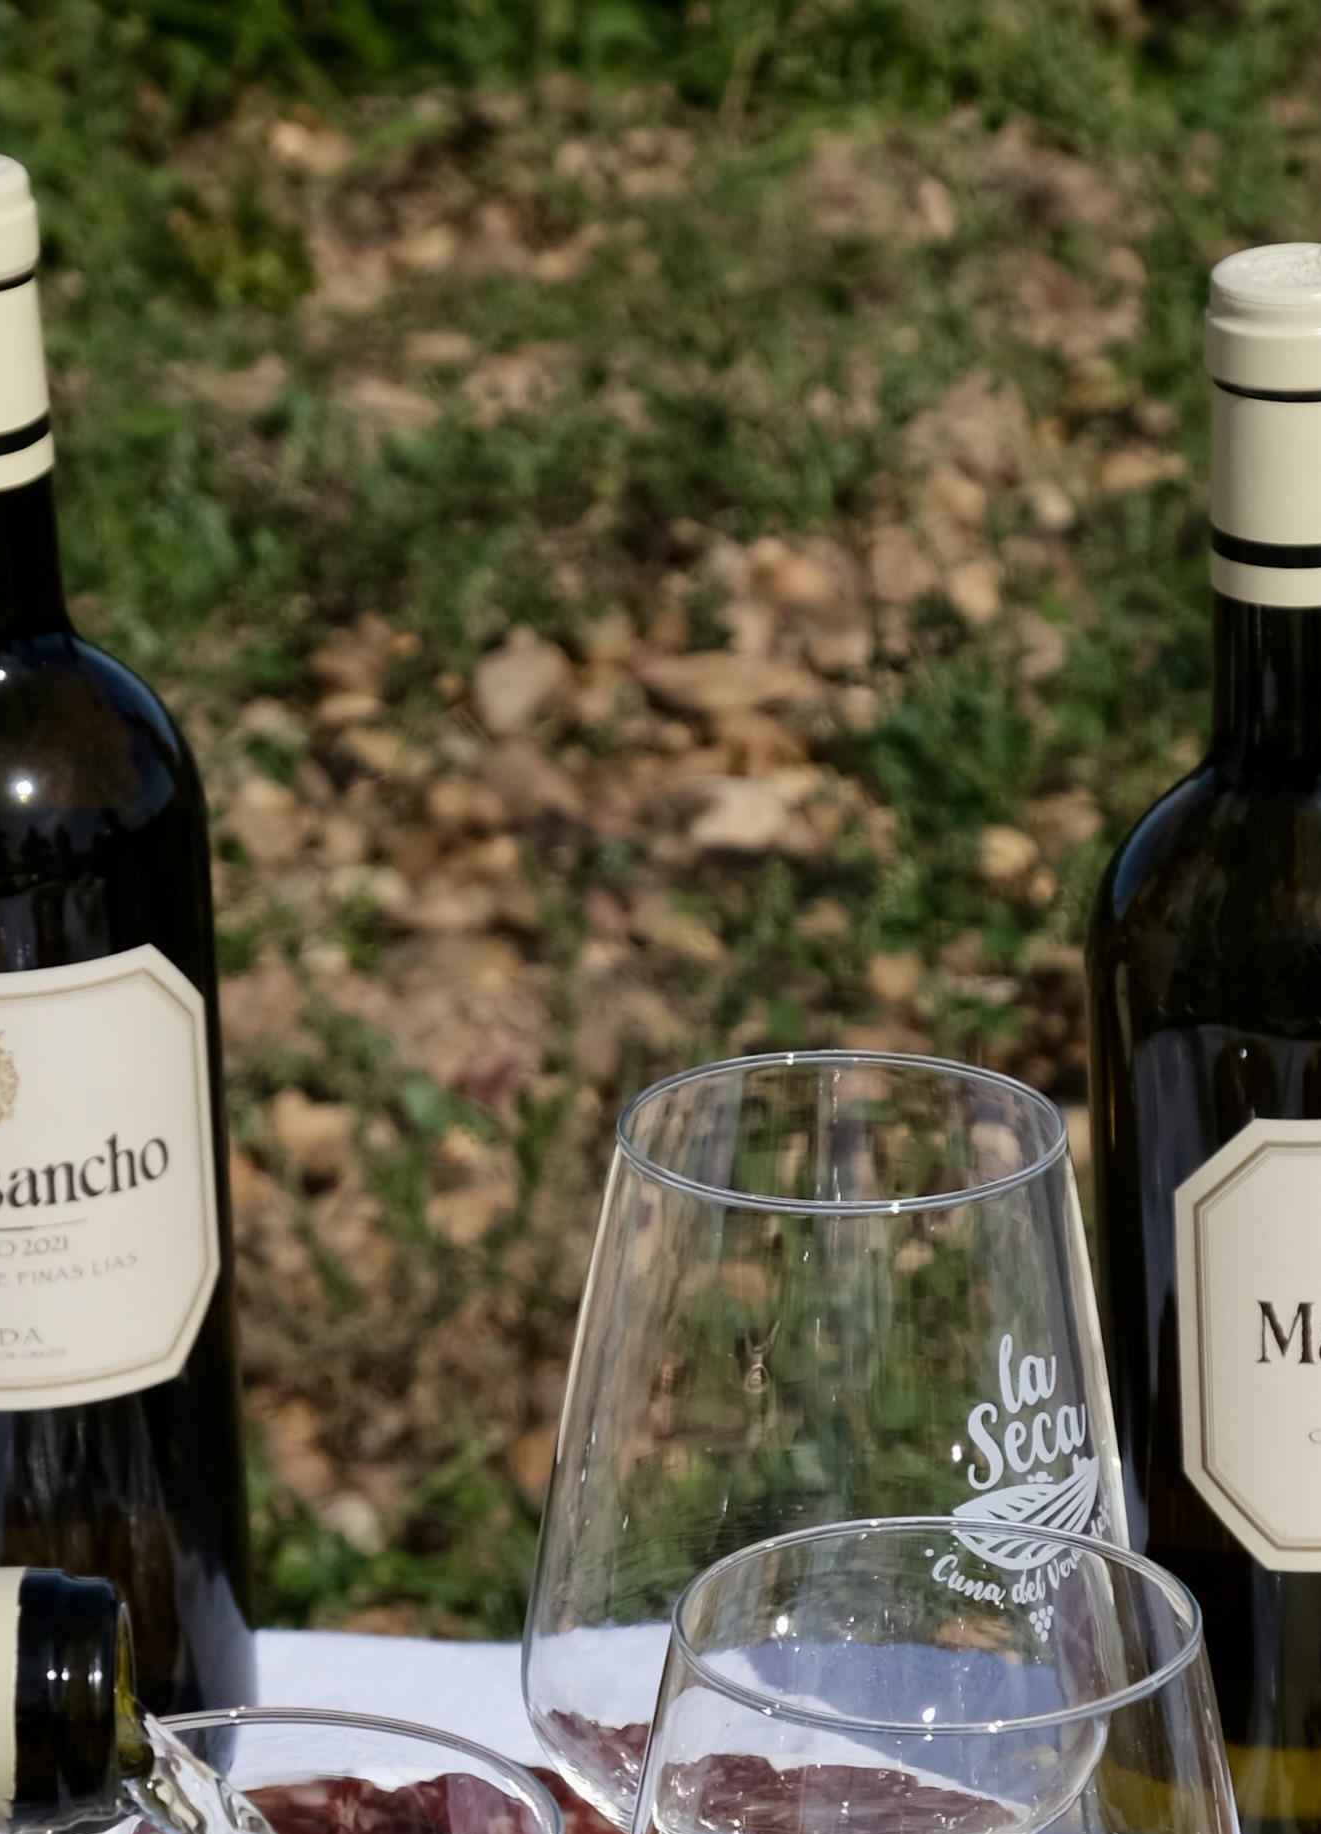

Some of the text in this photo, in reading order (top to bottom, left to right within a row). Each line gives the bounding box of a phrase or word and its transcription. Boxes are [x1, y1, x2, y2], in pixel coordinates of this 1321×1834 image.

[17, 1262, 84, 1287] FINAS
[90, 1249, 139, 1277] LIAS
[22, 1233, 70, 1258] 2021
[998, 1333, 1056, 1414] la
[967, 1402, 1086, 1490] Seca
[931, 1553, 1007, 1602] Cuna
[1011, 1567, 1047, 1605] del
